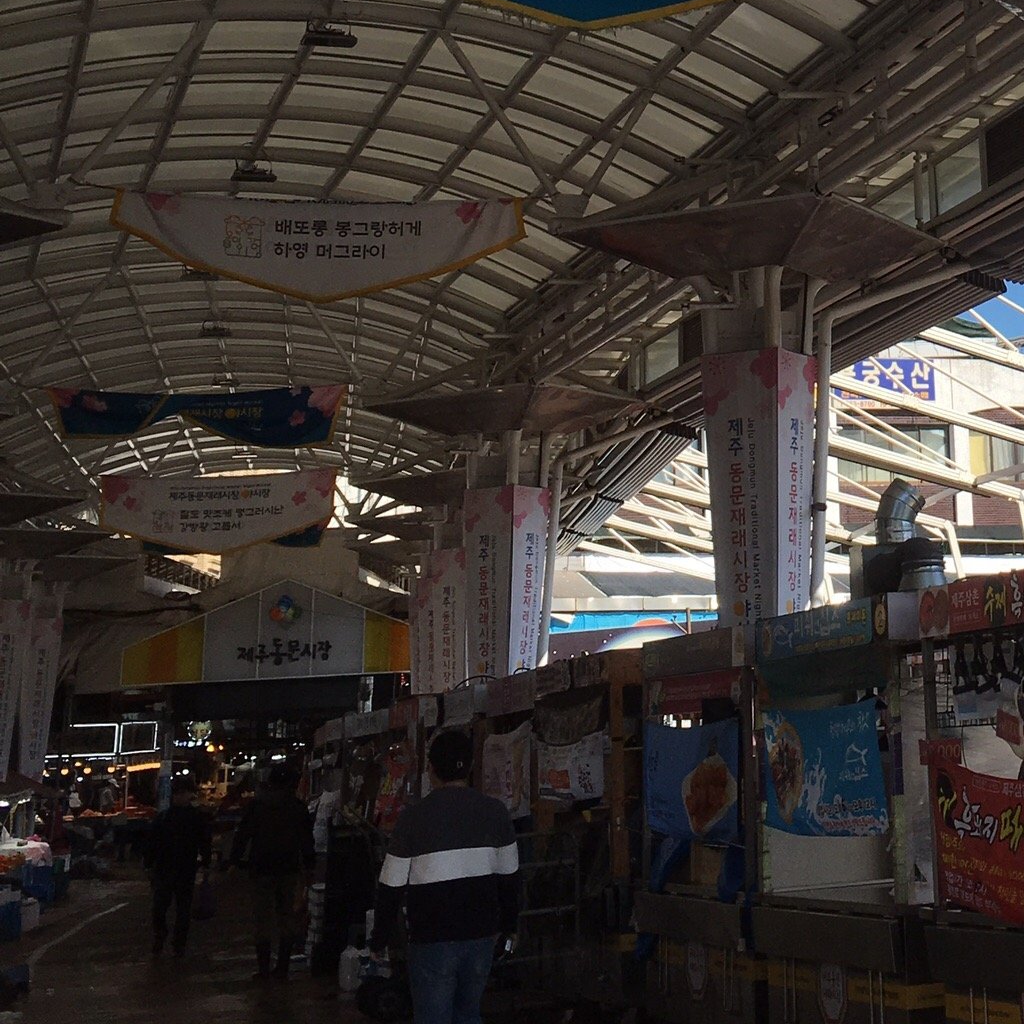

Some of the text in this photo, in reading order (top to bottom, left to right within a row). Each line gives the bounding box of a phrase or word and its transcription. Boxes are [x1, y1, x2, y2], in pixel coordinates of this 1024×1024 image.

[274, 219, 329, 237] 배또롱
[274, 241, 387, 260] 하영 머그라이
[728, 417, 743, 457] 제주
[747, 443, 757, 489] Dongmun
[729, 462, 751, 593] 동문재래시장
[236, 637, 332, 666] 제주동문시장
